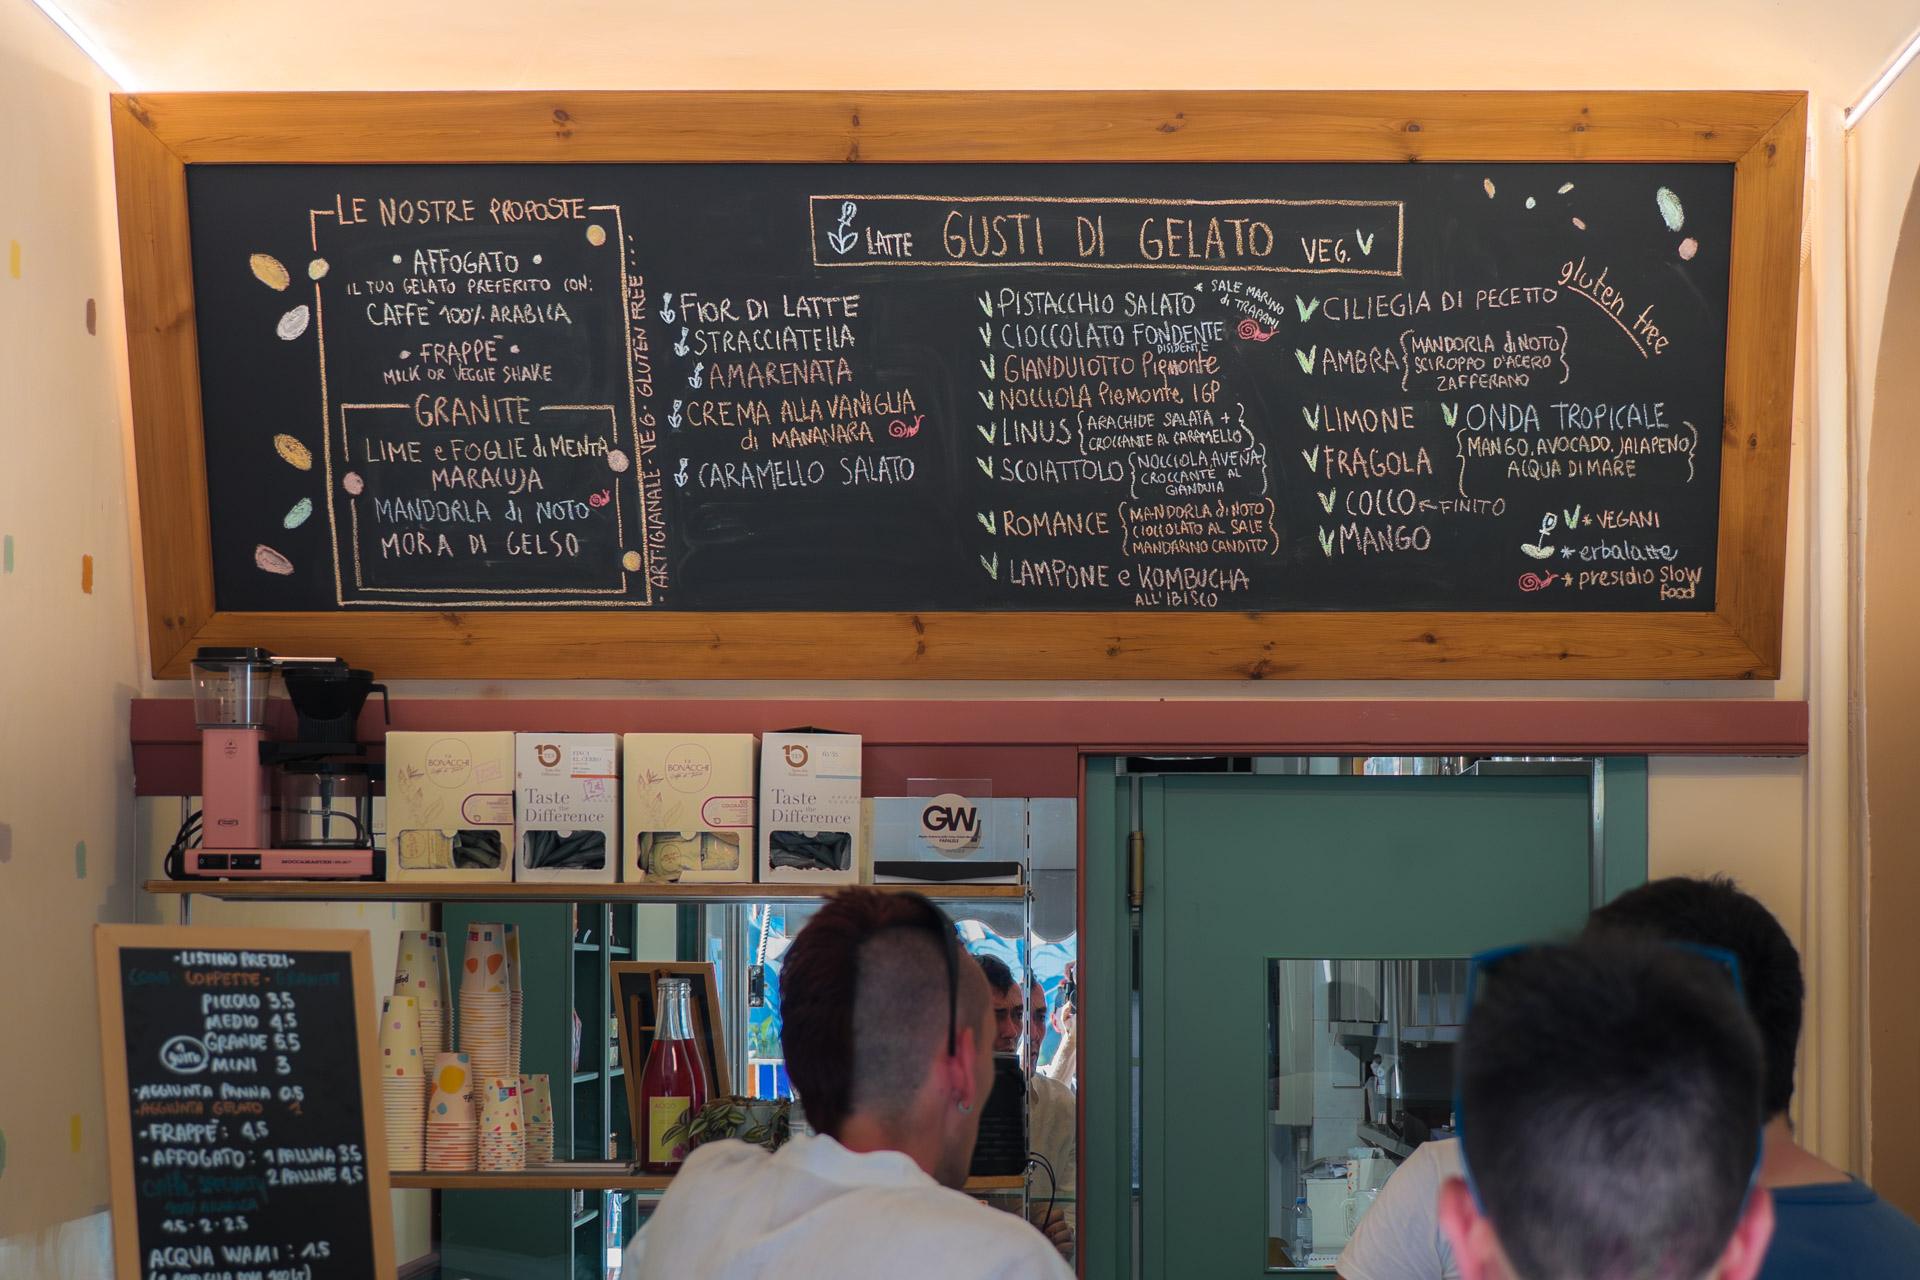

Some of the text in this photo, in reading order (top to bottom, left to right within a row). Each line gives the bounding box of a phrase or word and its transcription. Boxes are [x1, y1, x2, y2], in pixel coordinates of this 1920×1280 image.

[336, 194, 587, 227] LE NOSTRE PROPOSTE
[866, 210, 1351, 265] LATTE GUSTI DI GELATO VEG.
[413, 249, 520, 276] AFFOGATO
[347, 282, 362, 296] IL
[366, 280, 394, 294] TUO
[403, 278, 456, 295] GELATO
[468, 278, 551, 295] PREFERITO
[1211, 279, 1285, 316] SALE MARINO
[1557, 256, 1625, 316] gluten
[439, 304, 485, 326] 100%
[490, 302, 573, 325] ARABICA
[680, 292, 860, 323] FIOR DI LATTE
[997, 288, 1196, 318] PISTACCHIO SALATO
[1220, 293, 1280, 329] di TRAPANI
[1323, 287, 1558, 322] CILIEGIA DI PECETTO
[1001, 320, 1224, 349] CIOCCOLATO FONDENTE
[633, 327, 654, 397] GLUTEN
[1322, 330, 1560, 375] AMBRA MANDORLA di NOTO
[1415, 354, 1552, 374] SCIROPPO D'ACERO
[383, 363, 553, 385] MILK OR VEGGIE SHAKE
[709, 357, 853, 389] AMARENATA
[1004, 354, 1135, 384] GIANDUIOTTO
[1437, 372, 1530, 392] ZAFFERANO
[687, 388, 916, 427] CREMA ALLA VANIGLIA
[1000, 383, 1093, 410] NOCCIOLA
[1192, 379, 1220, 404] IGP
[414, 394, 532, 427] GRANITE
[1324, 402, 1669, 433] LIMONE ONDA TROPICALE
[740, 420, 875, 450] di MANANARA
[1002, 417, 1072, 446] LINUS
[1087, 413, 1156, 431] ARACHIDE
[1163, 409, 1214, 428] SALATA
[1088, 428, 1243, 452] CROCCANTE AL CARAMELLO
[365, 434, 609, 464] LIME e FOGLIE di MENTA
[1614, 434, 1690, 460] JALAPENO
[698, 455, 915, 490] CARAMELLO SALATO
[999, 457, 1125, 484] SCOIATTOLO
[1213, 449, 1263, 467] AVENA
[1141, 467, 1242, 485] CROCCANTE AL
[1323, 446, 1432, 480] FRAGOLA
[1507, 459, 1637, 480] ACQUA DI MARE
[431, 467, 543, 495] MARACUJA
[1166, 480, 1225, 496] GIANDUIA
[375, 498, 590, 524] MANDORLA di NOTO
[1346, 488, 1506, 516] COCCO FINITO
[644, 467, 670, 589] ARTIGIANALE
[1003, 510, 1109, 537] ROMANCE
[1130, 503, 1213, 523] MANDORLA
[1231, 501, 1265, 517] NOTO
[1132, 519, 1263, 539] CIOCCOLATO AL SALE
[1596, 509, 1661, 529] VEGANI
[380, 533, 580, 559] MORA DI GELSO
[1132, 538, 1268, 556] MANDARINO CANDITO
[1339, 521, 1432, 557] MANGO
[1579, 538, 1679, 562] erbalatte
[1010, 559, 1250, 592] LAMPONE e KOMBUCHA
[1579, 566, 1654, 590] presidio
[1660, 581, 1696, 600] food
[524, 788, 570, 805] Taste
[771, 788, 816, 806] Taste
[526, 808, 604, 823] Difference
[772, 808, 851, 824] Difference
[922, 805, 977, 832] GW
[182, 951, 238, 966] LISTINO
[185, 970, 261, 986] COPPETTE
[202, 993, 260, 1014] PICCOLO
[205, 1014, 259, 1030] MEDIO
[204, 1032, 267, 1053] GRANDE
[212, 1056, 291, 1074] MINI 3
[220, 1082, 271, 1099] PANNA
[266, 1170, 279, 1186] 2
[149, 1245, 215, 1269] ACQUA
